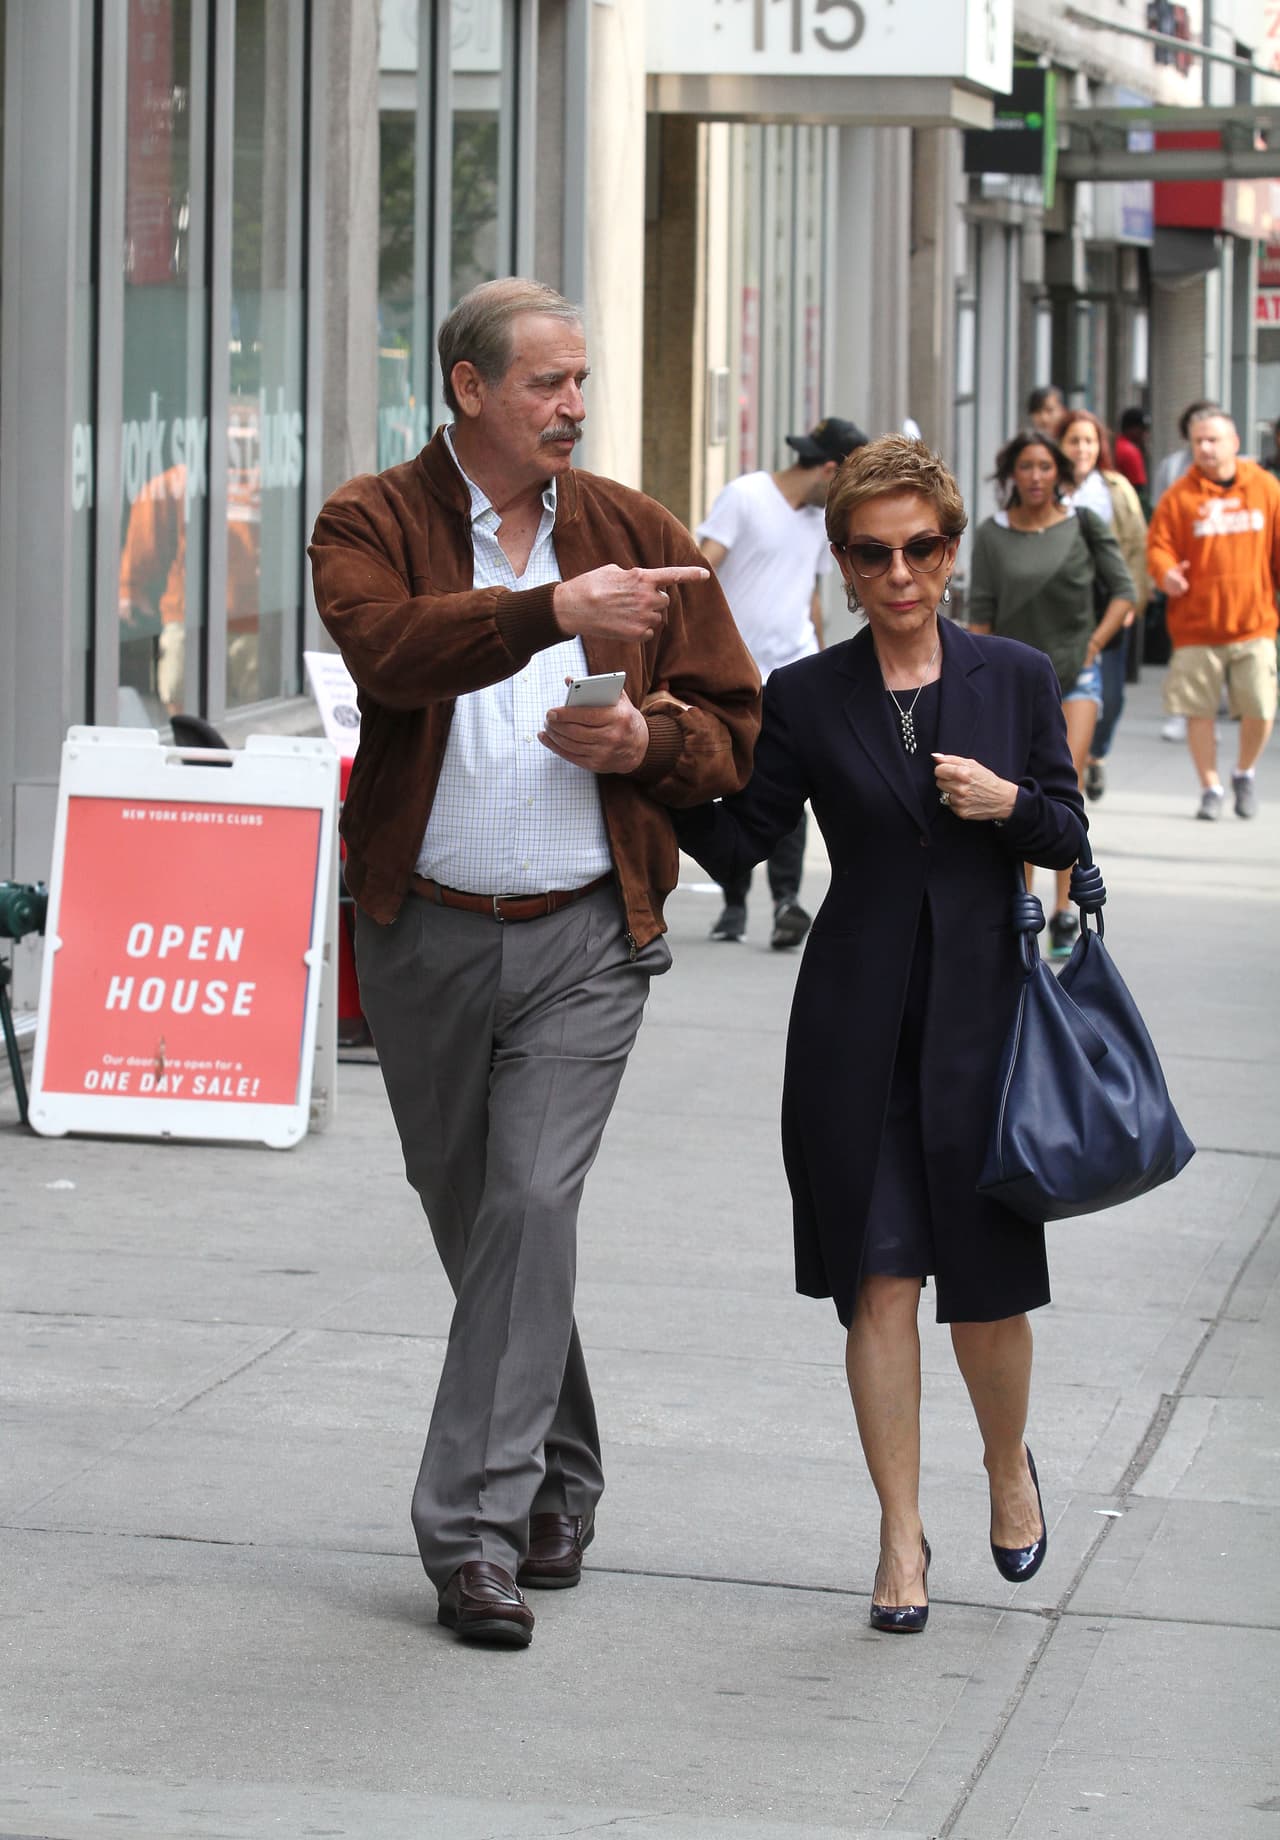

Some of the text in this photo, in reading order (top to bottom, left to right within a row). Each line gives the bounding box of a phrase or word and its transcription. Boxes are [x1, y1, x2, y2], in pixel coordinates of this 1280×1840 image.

[738, 0, 866, 53] 115
[122, 808, 264, 826] NEW YORK SPORTS CLUBS
[126, 922, 245, 962] OPEN
[105, 975, 257, 1017] HOUSE
[102, 1054, 124, 1066] Our
[184, 1059, 213, 1071] open
[215, 1059, 232, 1070] for
[84, 1069, 260, 1098] ONE DAY SALE!
